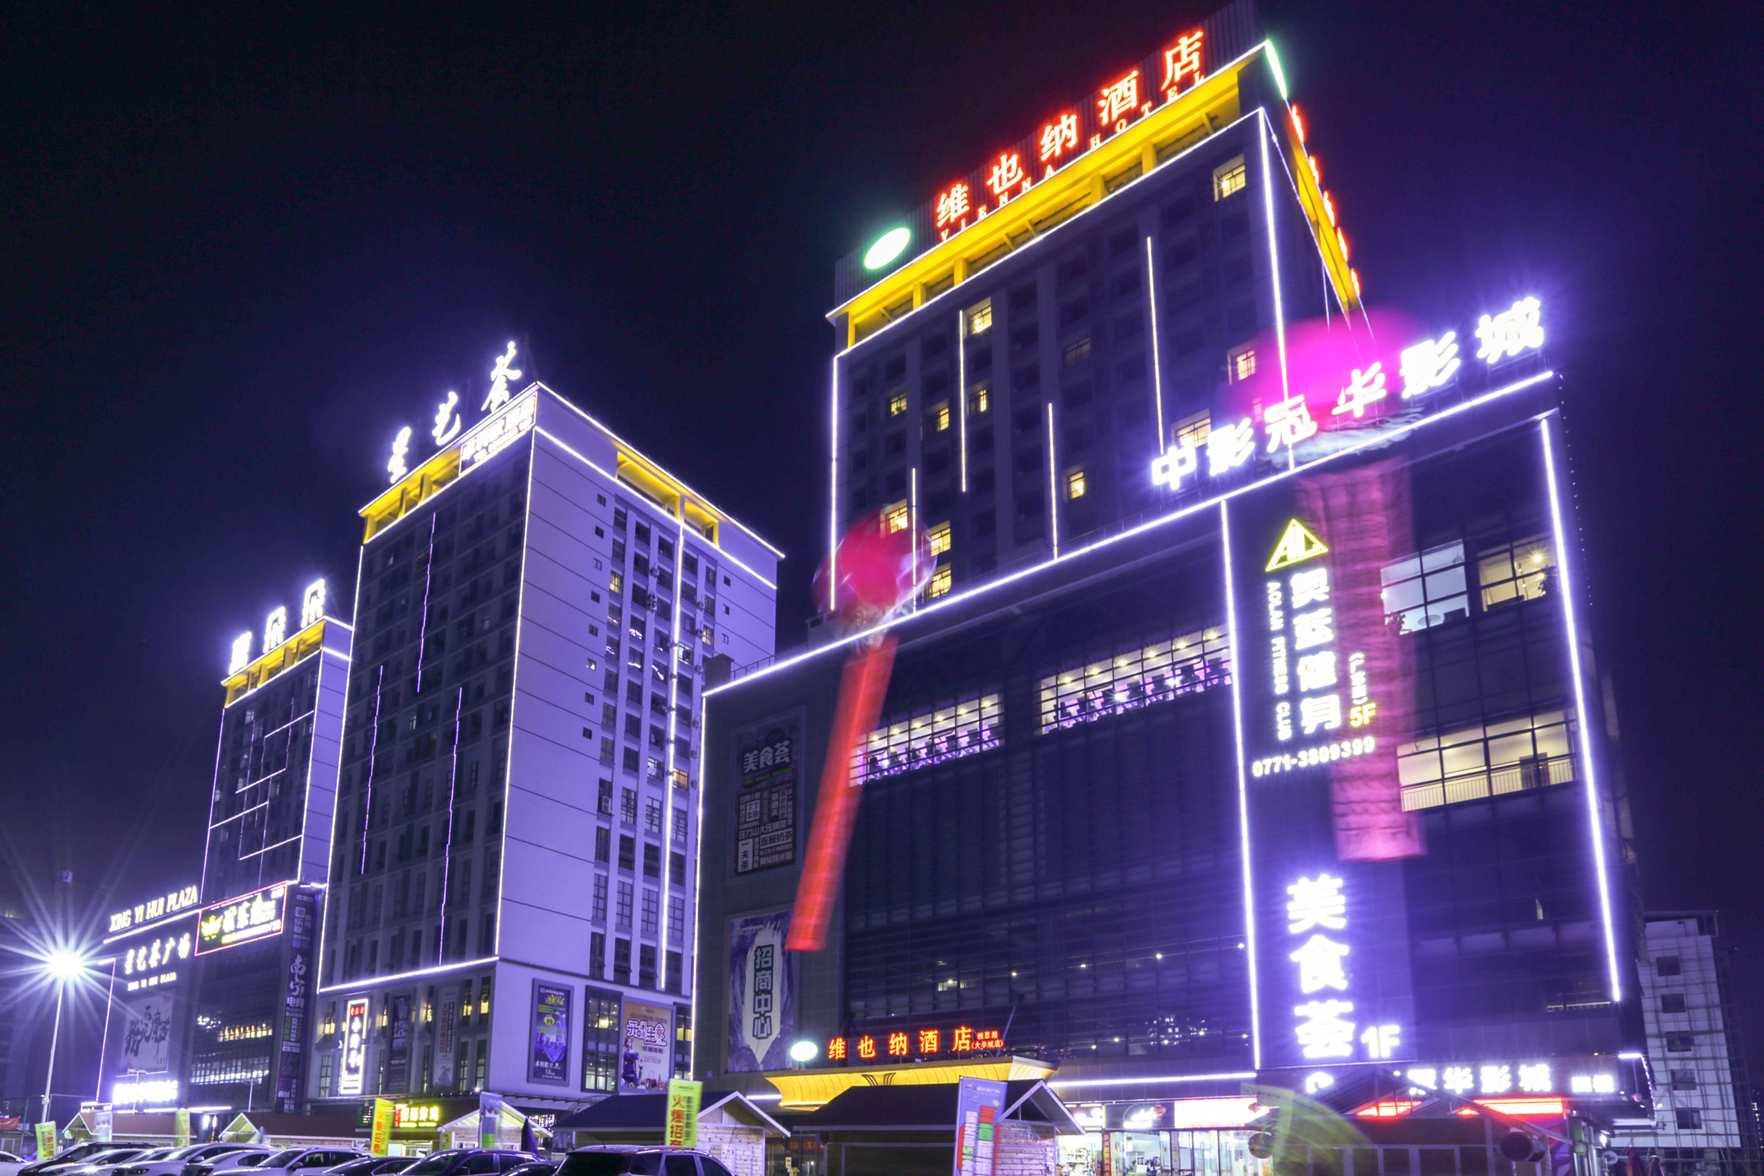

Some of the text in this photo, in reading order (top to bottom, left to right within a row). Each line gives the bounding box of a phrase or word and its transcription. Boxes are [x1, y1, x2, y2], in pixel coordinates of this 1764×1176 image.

[935, 30, 1204, 230] 维也纳酒店
[940, 71, 1207, 243] VIENNA HOTEL
[1150, 296, 1544, 491] 中影冠华影城
[1267, 581, 1285, 631] AOLAN
[1276, 701, 1293, 741] CLUB
[1350, 701, 1376, 728] 5F
[743, 740, 791, 774] 美食荟
[1252, 736, 1376, 778] 0771-3809399
[109, 885, 198, 932] XING YI HUI PLAZA
[753, 945, 774, 1040] 招商中心
[1285, 873, 1356, 1060] 美食荟
[828, 1026, 973, 1060] 维也纳酒店
[1359, 1023, 1401, 1060] 1F
